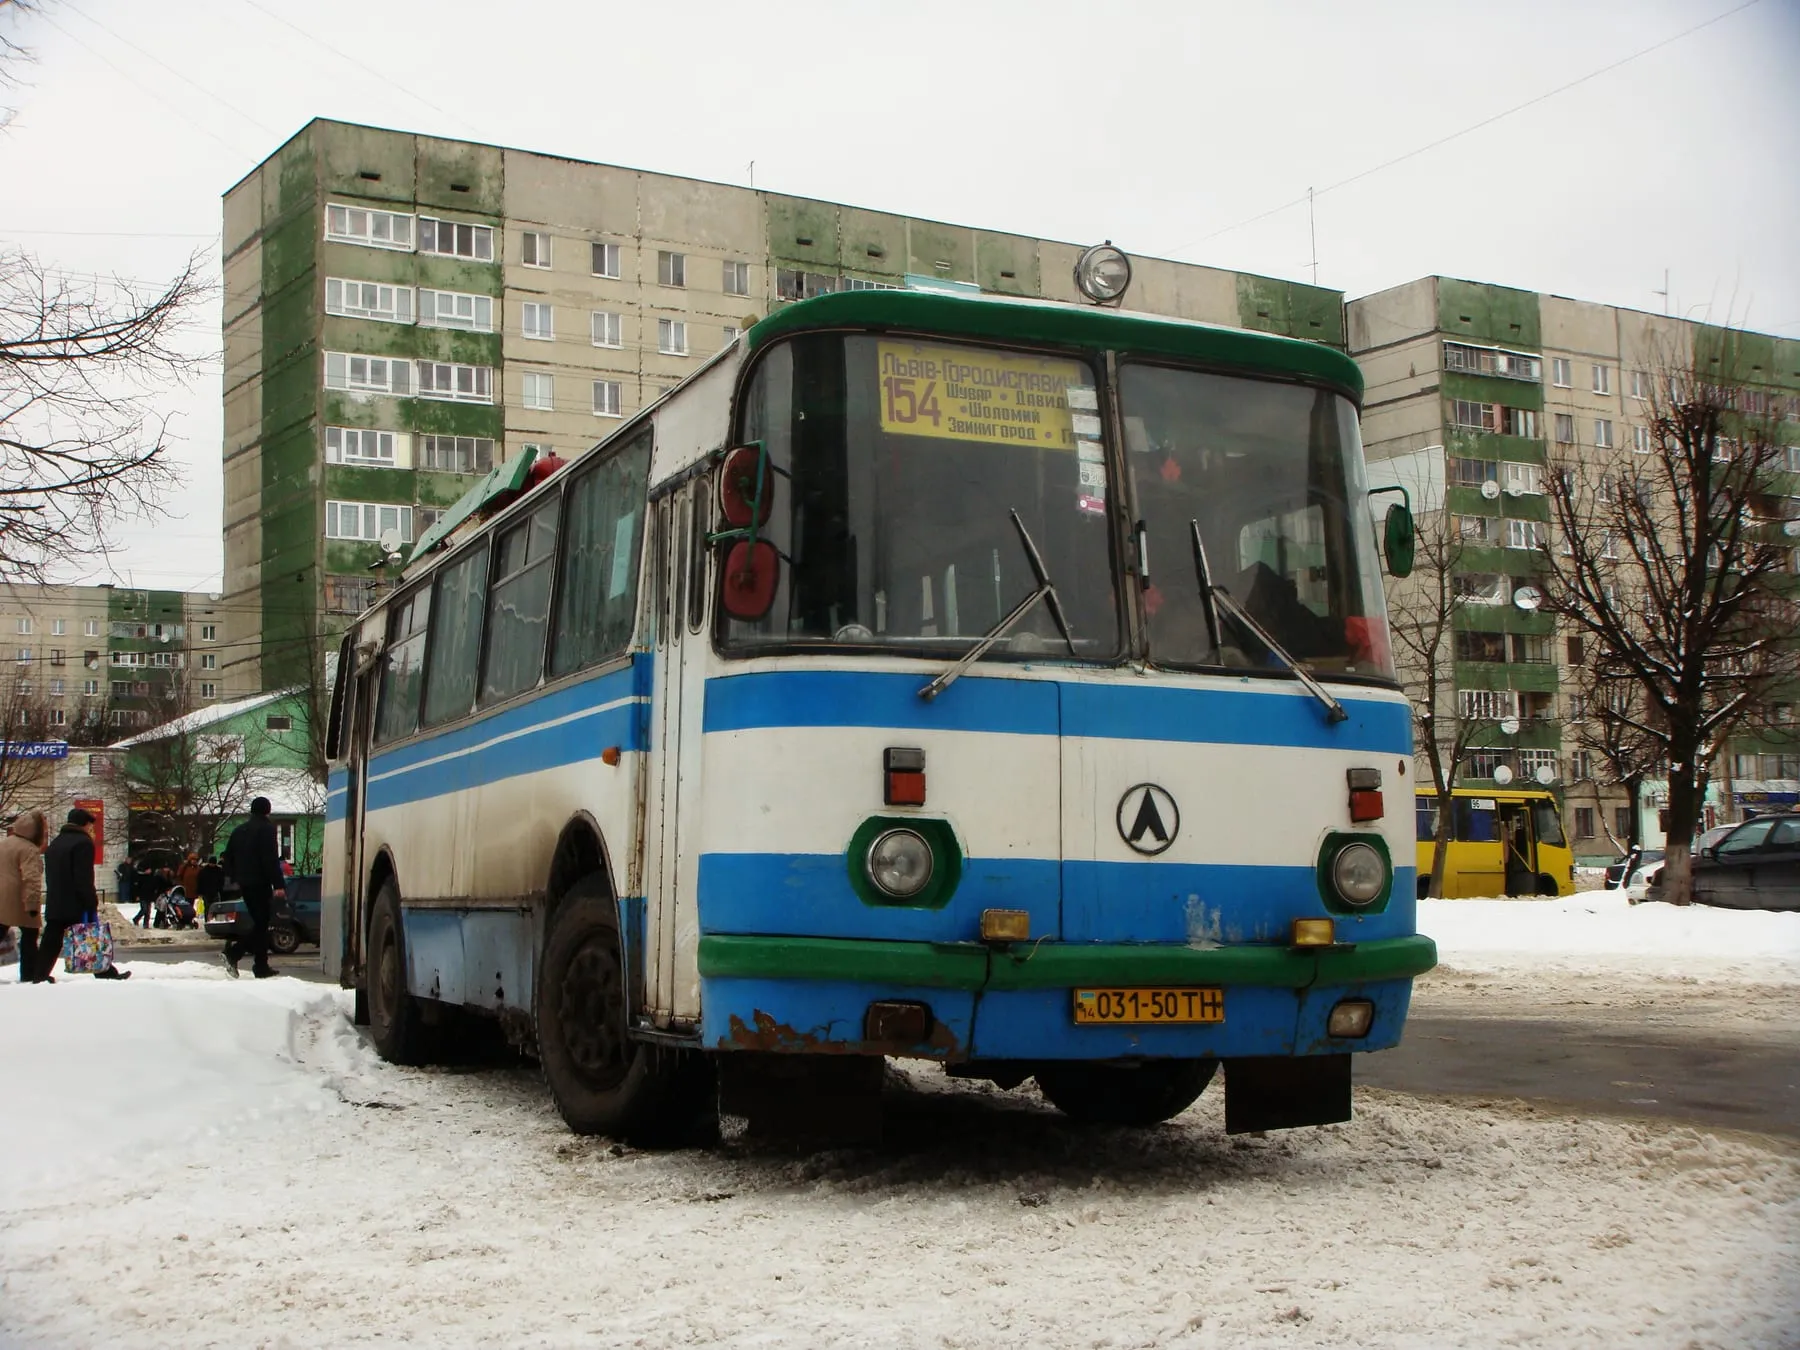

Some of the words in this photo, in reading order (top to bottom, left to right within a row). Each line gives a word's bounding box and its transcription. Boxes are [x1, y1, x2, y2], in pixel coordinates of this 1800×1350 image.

[883, 376, 941, 427] 154
[1015, 390, 1067, 410] ДАВИД
[1082, 1007, 1096, 1018] 14
